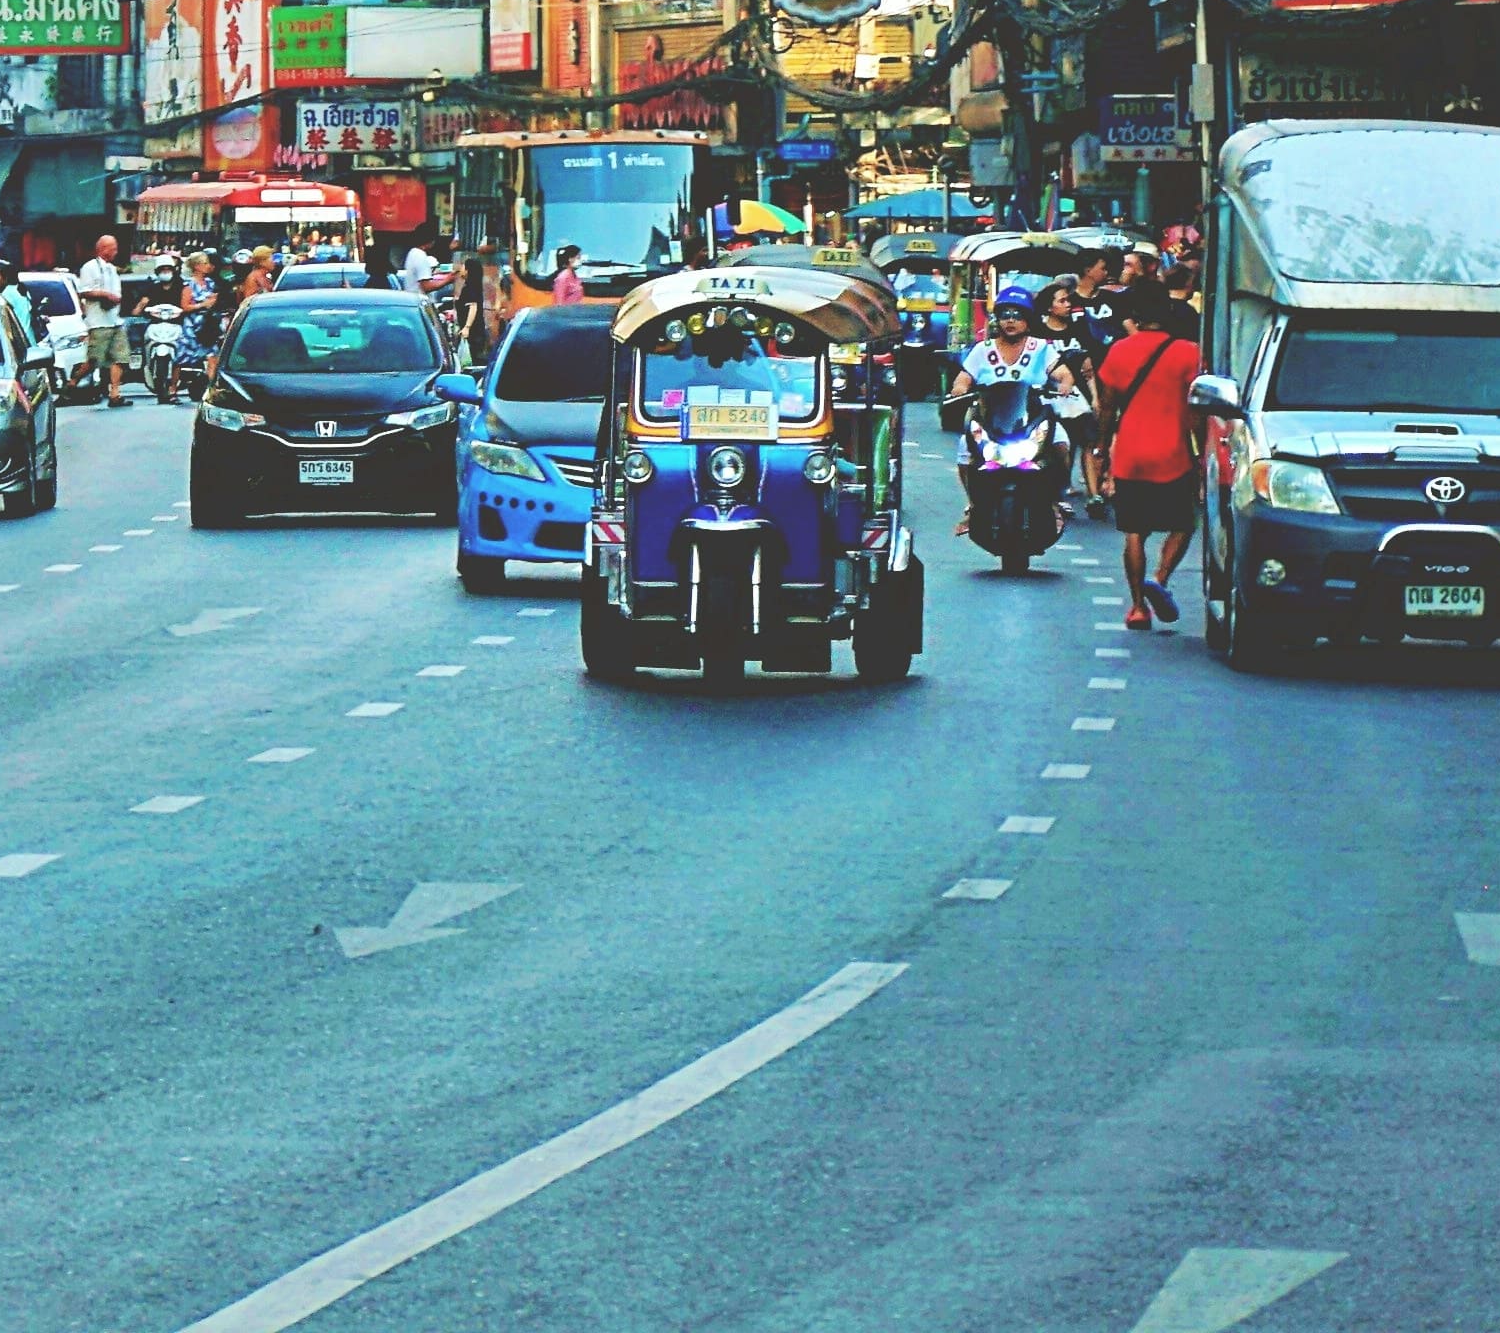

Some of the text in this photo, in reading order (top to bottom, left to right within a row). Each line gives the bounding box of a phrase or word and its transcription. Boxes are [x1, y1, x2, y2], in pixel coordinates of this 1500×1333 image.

[608, 151, 617, 170] 1
[822, 251, 852, 263] TAXI
[710, 277, 756, 289] TAXI
[728, 408, 769, 422] 5240
[325, 462, 352, 473] 6345
[1439, 587, 1481, 605] 2604
